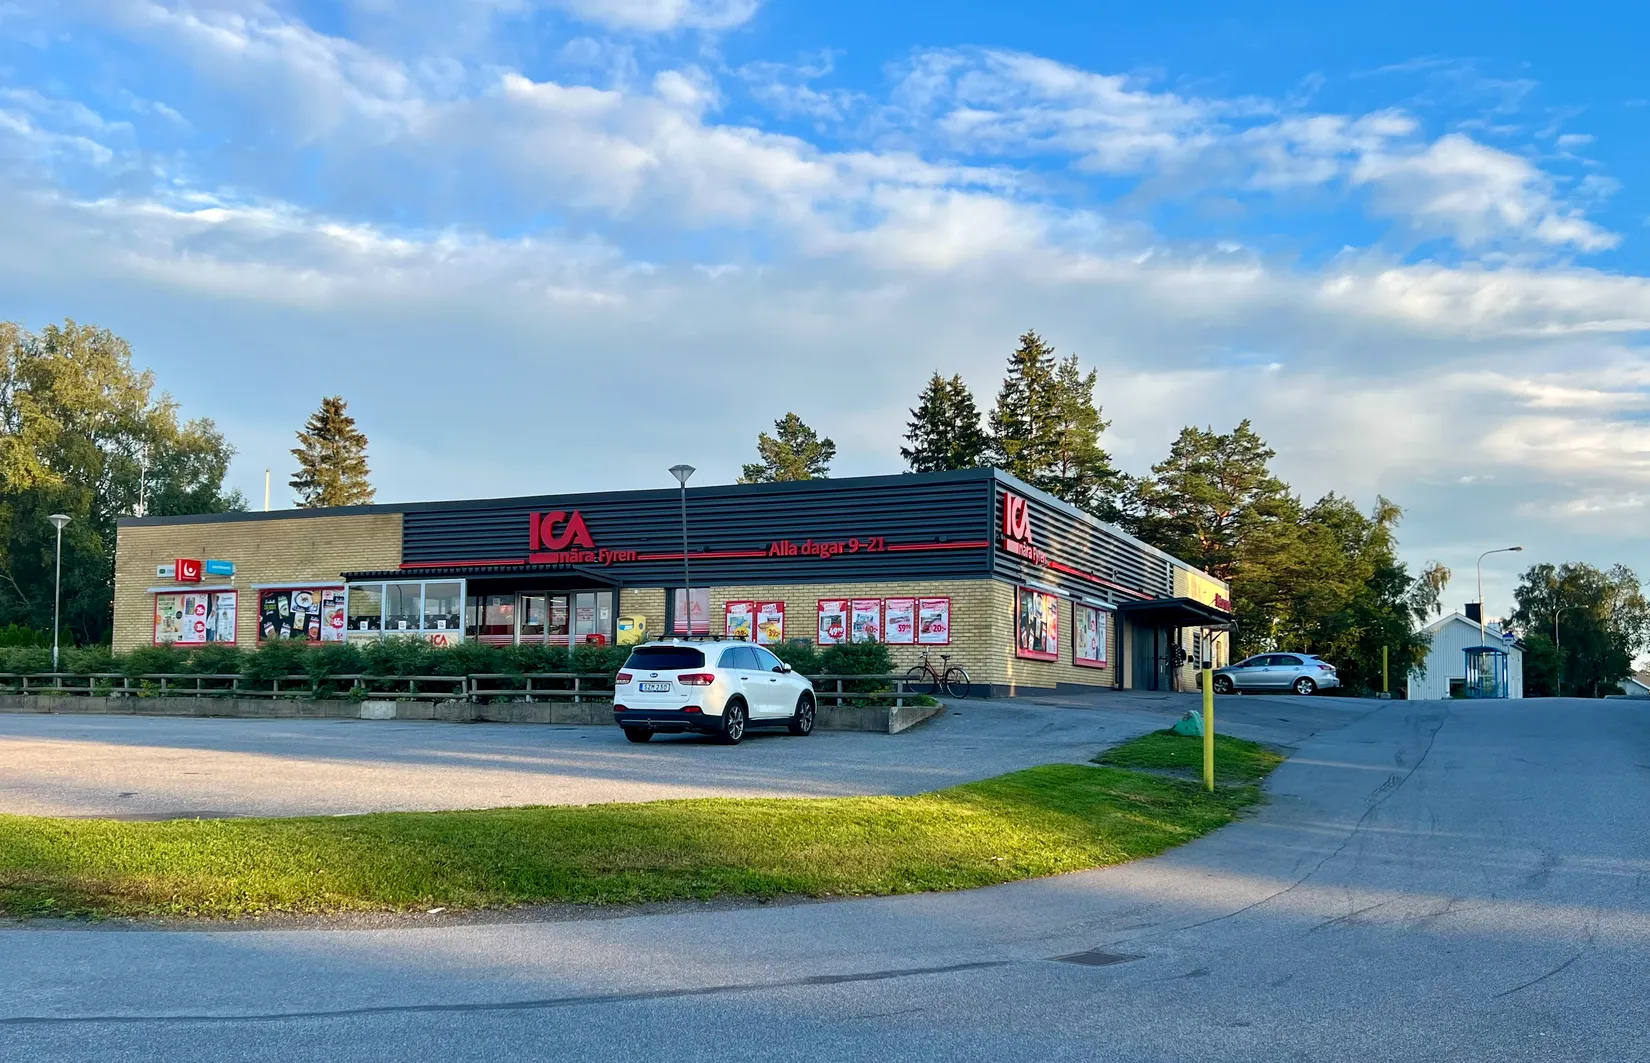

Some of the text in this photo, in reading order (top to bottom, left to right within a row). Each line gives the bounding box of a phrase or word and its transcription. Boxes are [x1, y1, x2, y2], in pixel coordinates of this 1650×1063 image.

[1003, 491, 1033, 544] ICA
[529, 509, 596, 550] ICA
[559, 547, 637, 567] nära Fyren
[768, 539, 799, 557] Alla
[801, 538, 846, 559] dagar
[1017, 540, 1033, 560] nära
